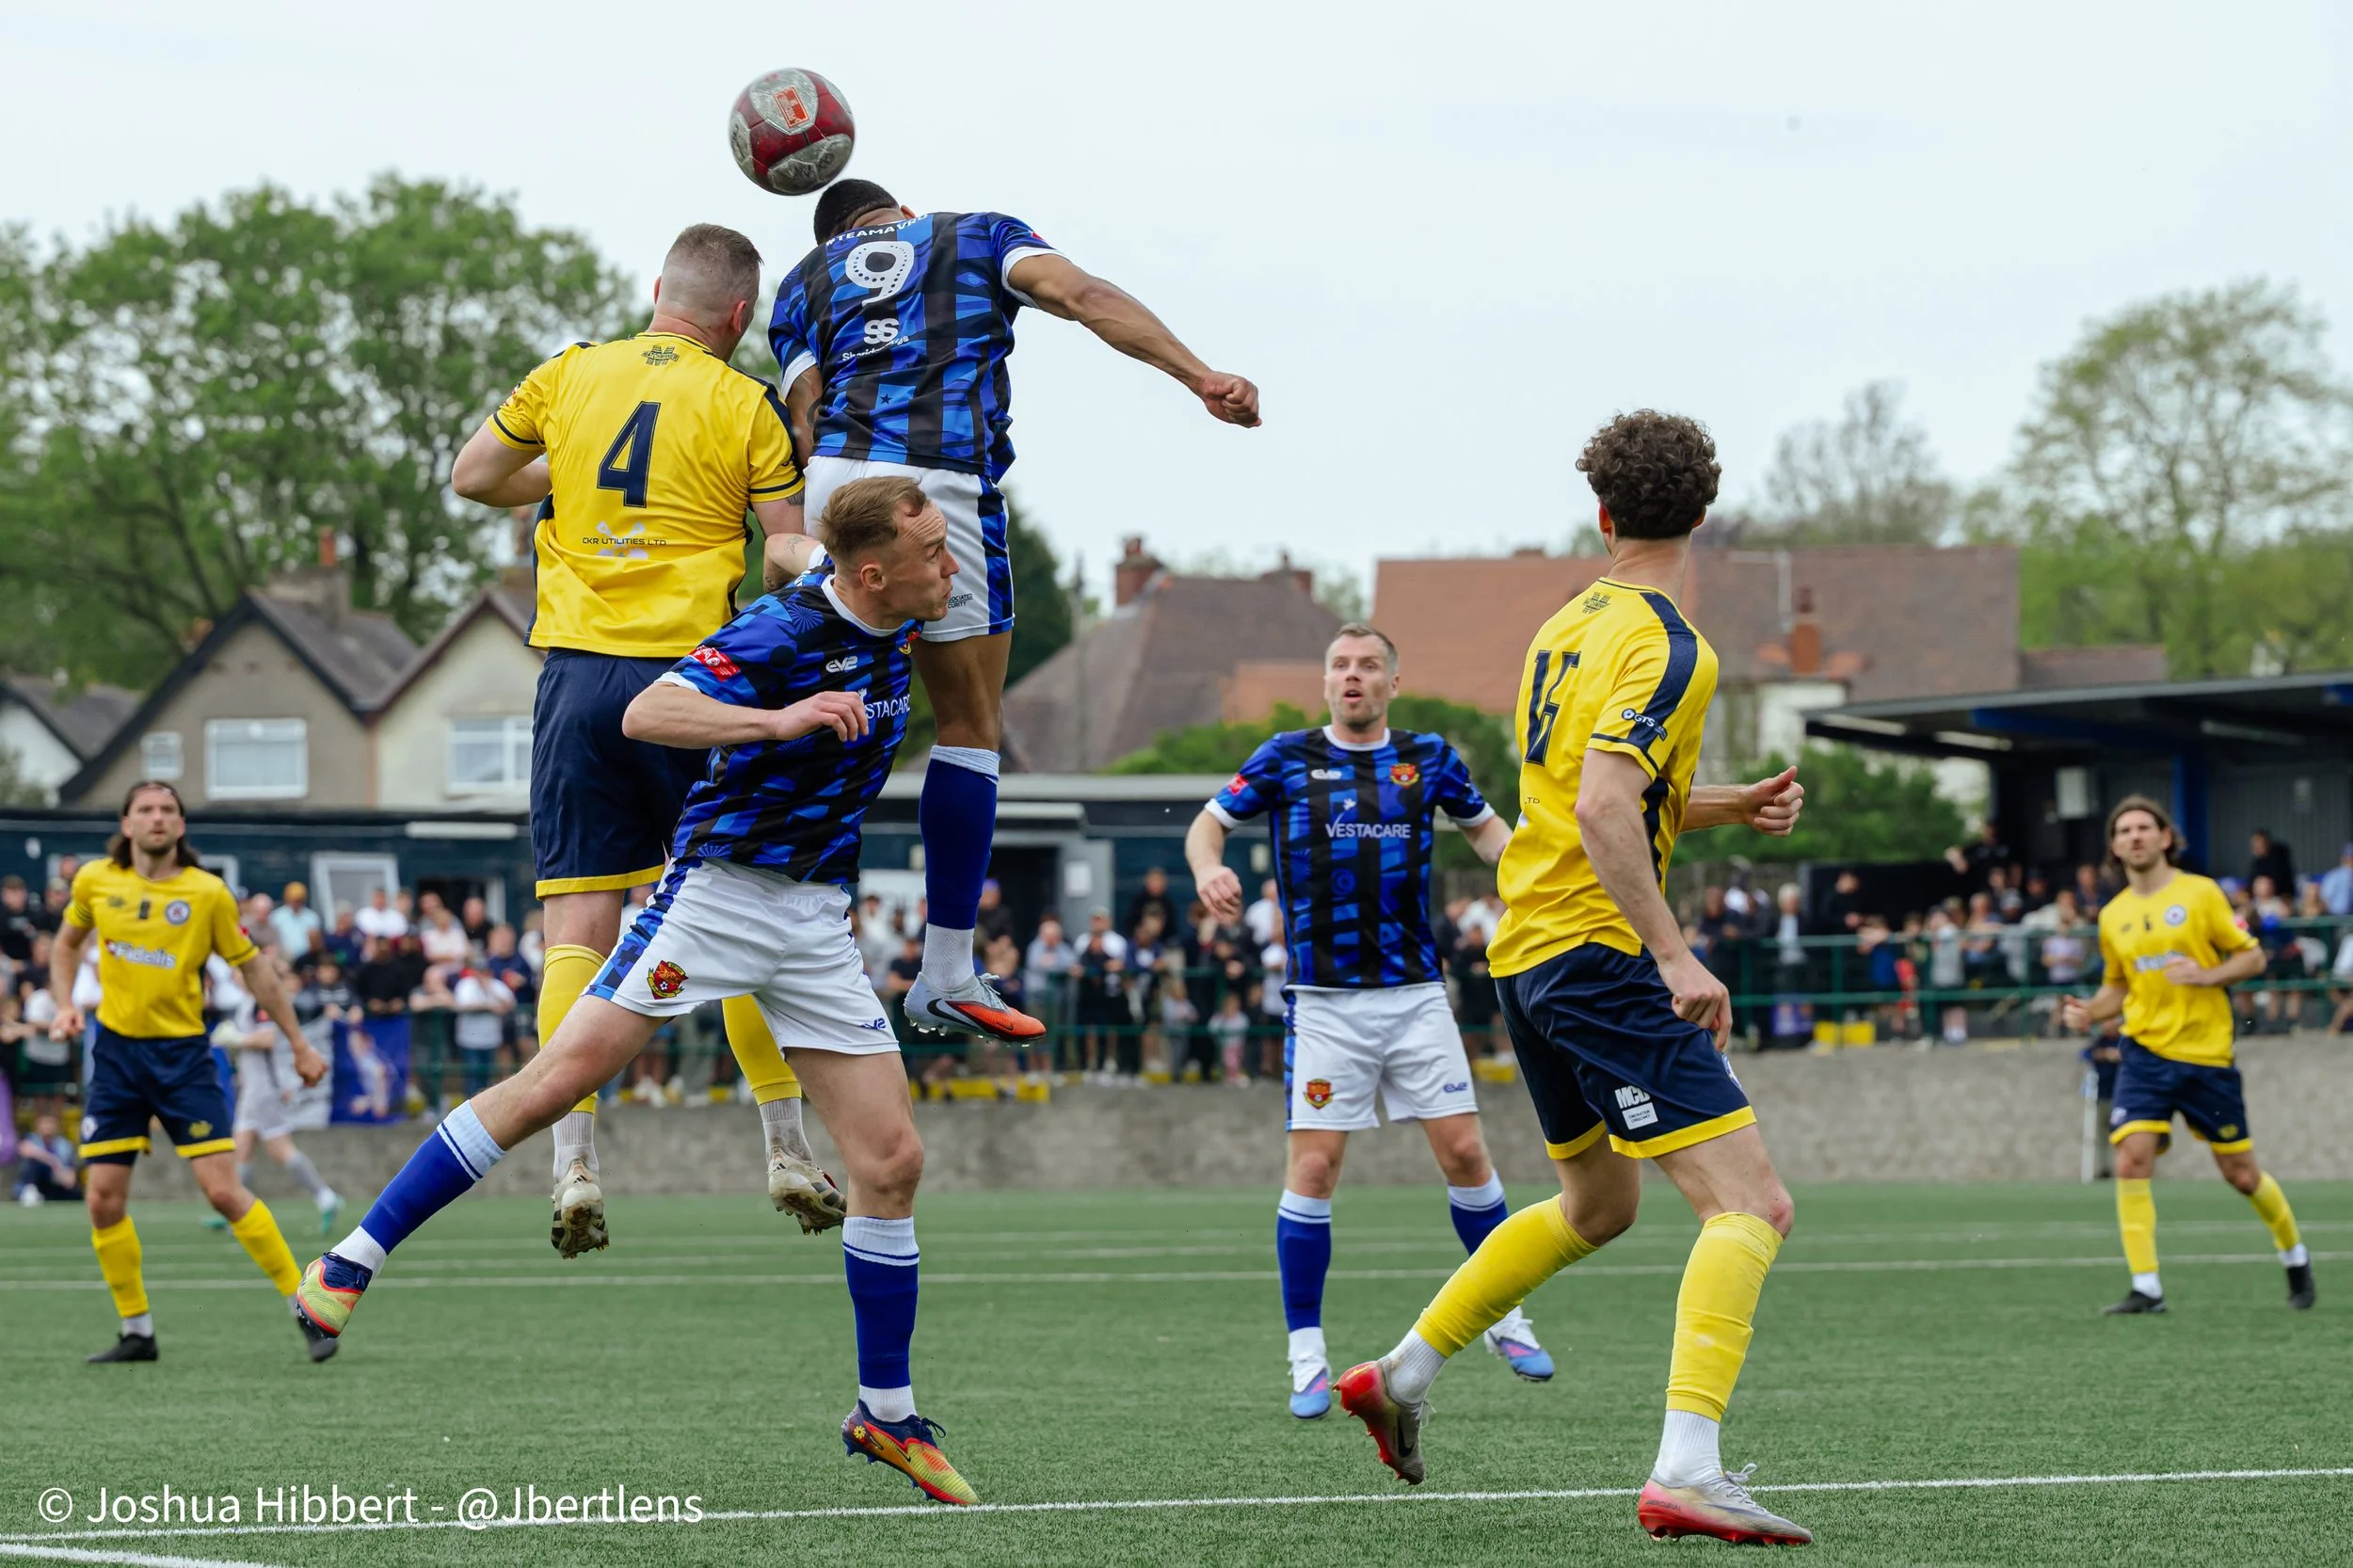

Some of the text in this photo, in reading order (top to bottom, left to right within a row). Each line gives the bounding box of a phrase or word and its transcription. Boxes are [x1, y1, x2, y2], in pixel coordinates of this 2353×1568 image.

[845, 241, 915, 307] 9
[597, 401, 662, 508] 4
[582, 536, 600, 545] CKR
[601, 536, 646, 545] UTILITIES
[864, 694, 911, 719] STACAR
[1634, 713, 1656, 728] GTS
[1324, 823, 1412, 839] VESTACARE
